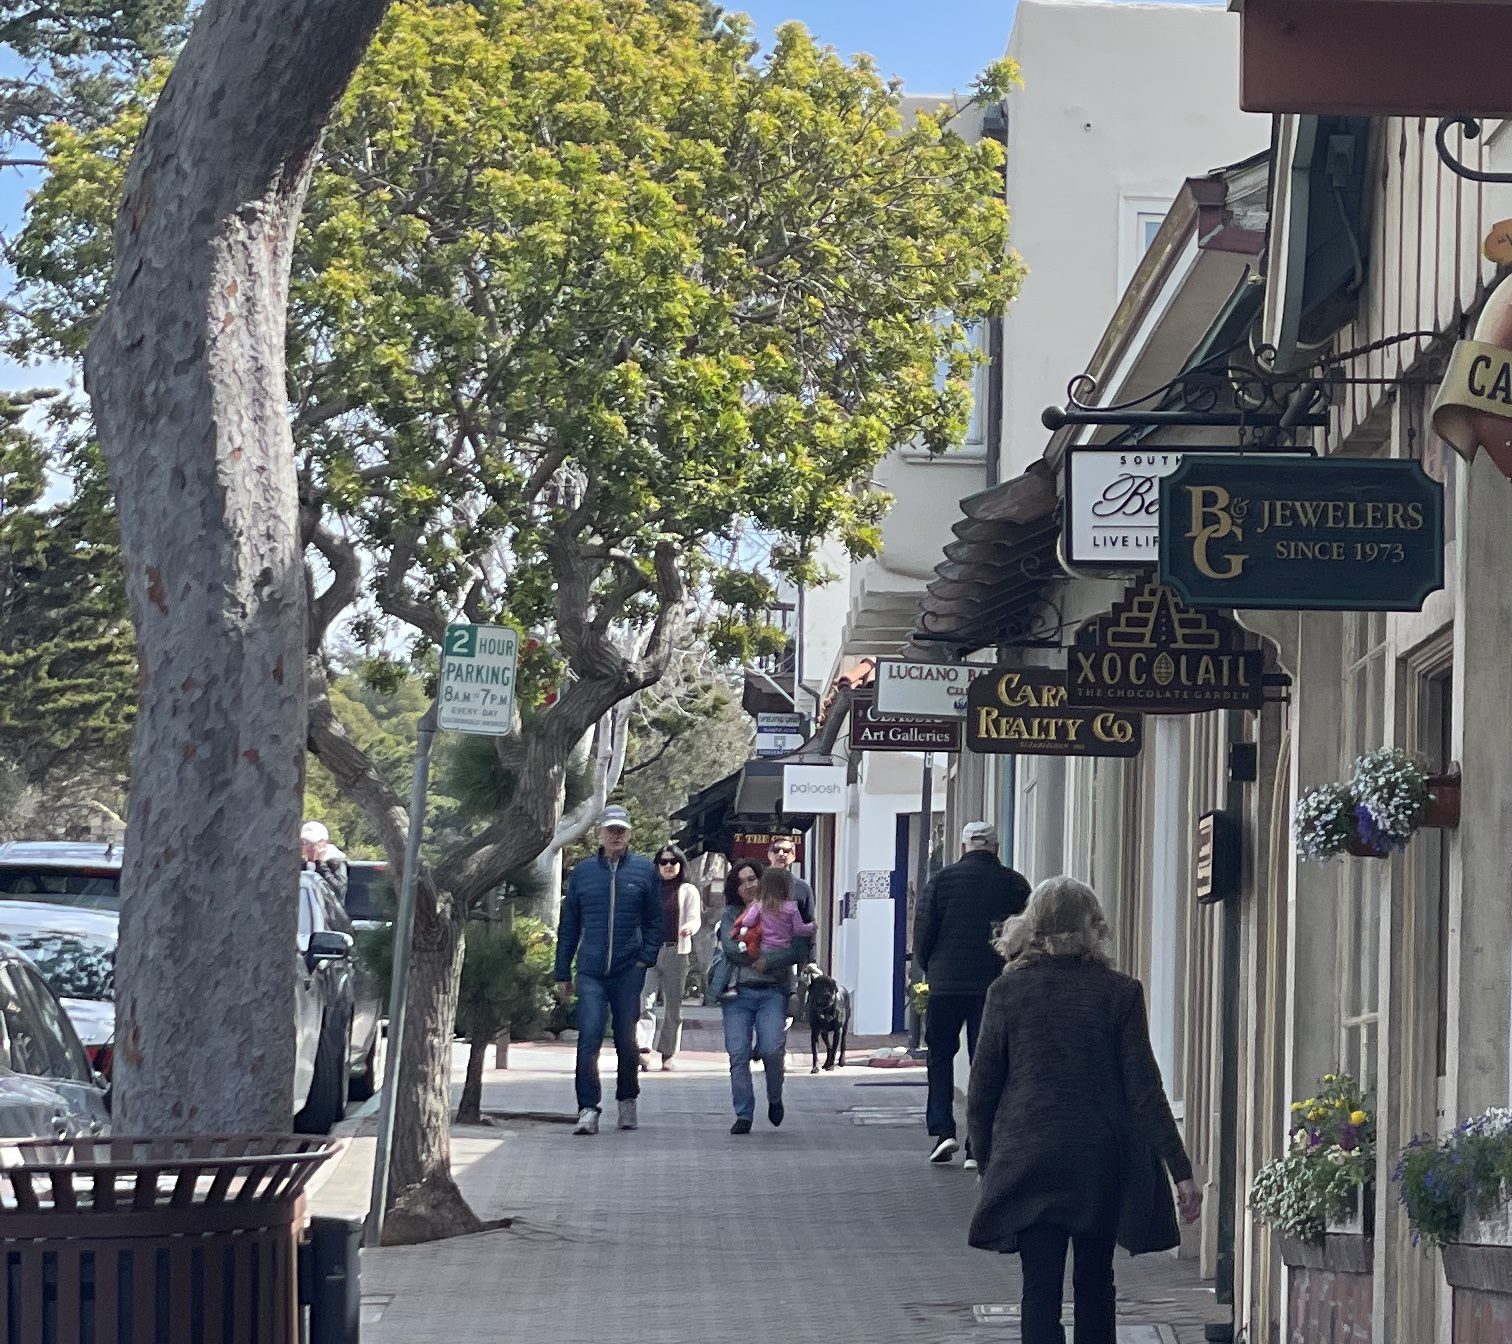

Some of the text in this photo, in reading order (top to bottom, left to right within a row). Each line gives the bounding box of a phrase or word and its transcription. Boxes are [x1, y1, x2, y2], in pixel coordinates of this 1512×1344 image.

[1256, 498, 1424, 534] JEWELERS
[1093, 535, 1160, 547] LIVE LIF
[1275, 540, 1405, 564] SINCE 1973
[452, 629, 514, 656] 2 HOUR
[446, 662, 511, 687] PARKING
[888, 664, 959, 682] LUCIANO
[1078, 687, 1250, 700] THE CHOCOLATE GARDEN
[451, 706, 499, 717] EVERY DAY
[977, 706, 1085, 742] REALTY
[860, 727, 950, 742] Art Galleries
[790, 783, 841, 795] paloosh
